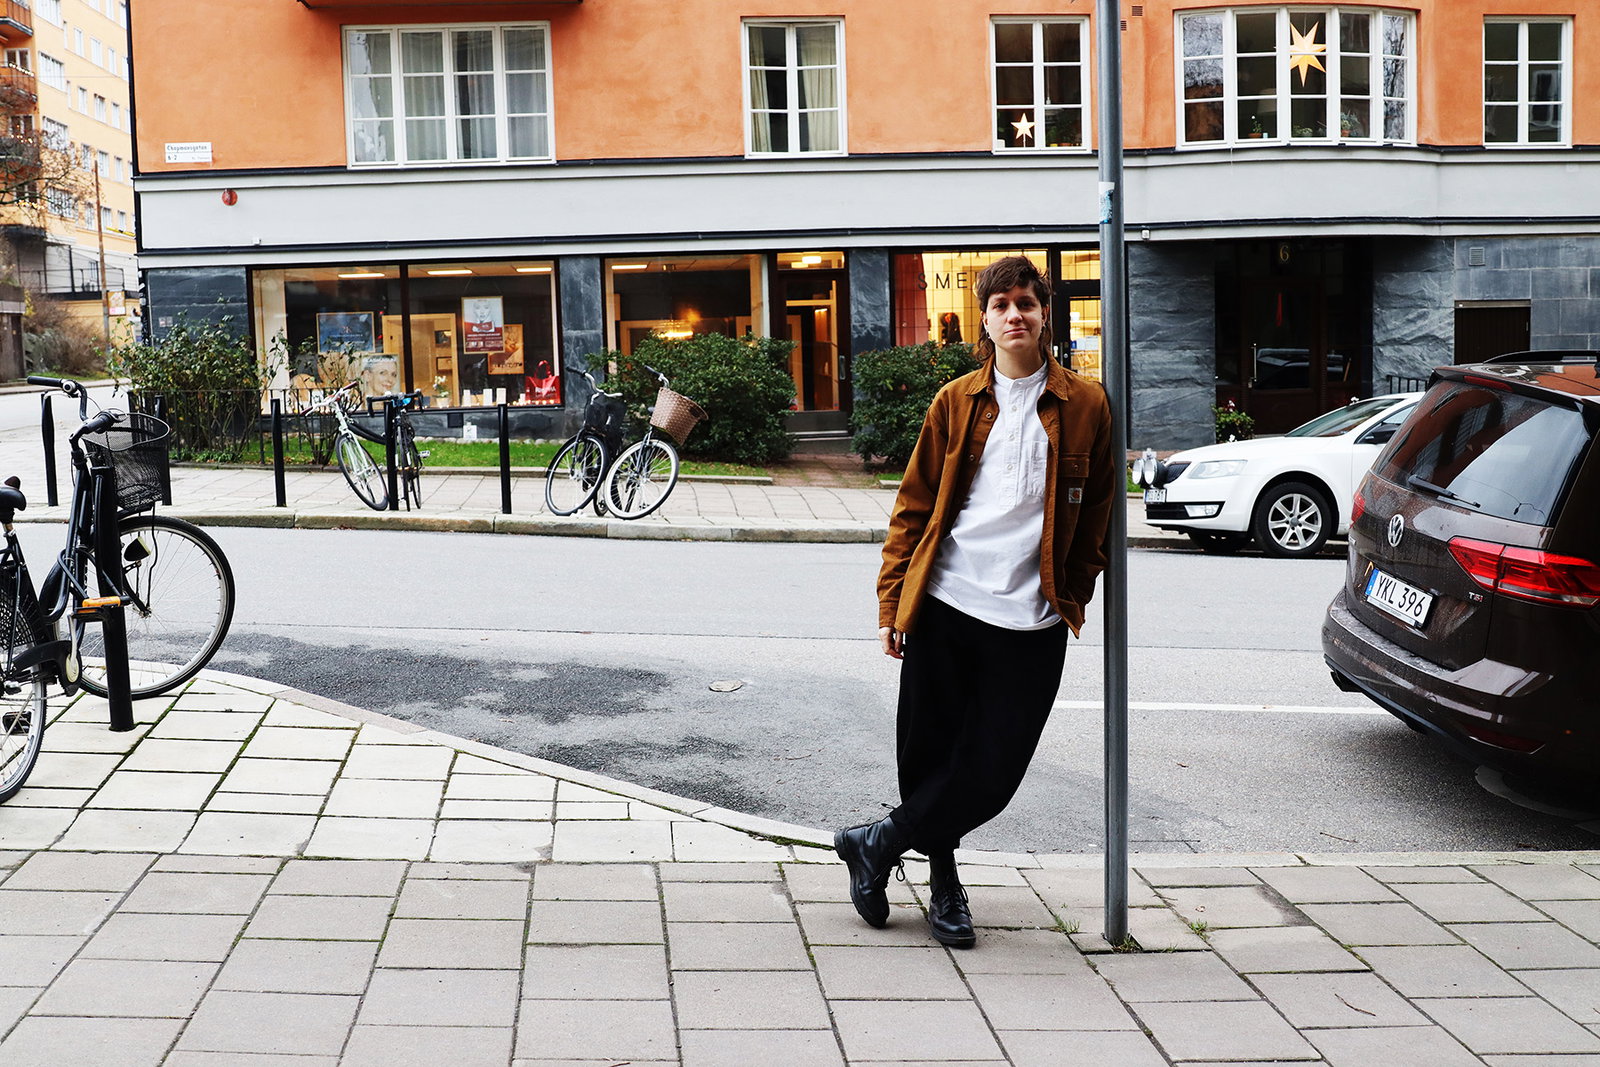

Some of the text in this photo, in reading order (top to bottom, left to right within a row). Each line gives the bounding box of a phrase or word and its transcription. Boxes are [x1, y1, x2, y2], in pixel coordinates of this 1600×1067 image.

[1279, 244, 1289, 262] 6
[1375, 575, 1425, 617] YKL 396
